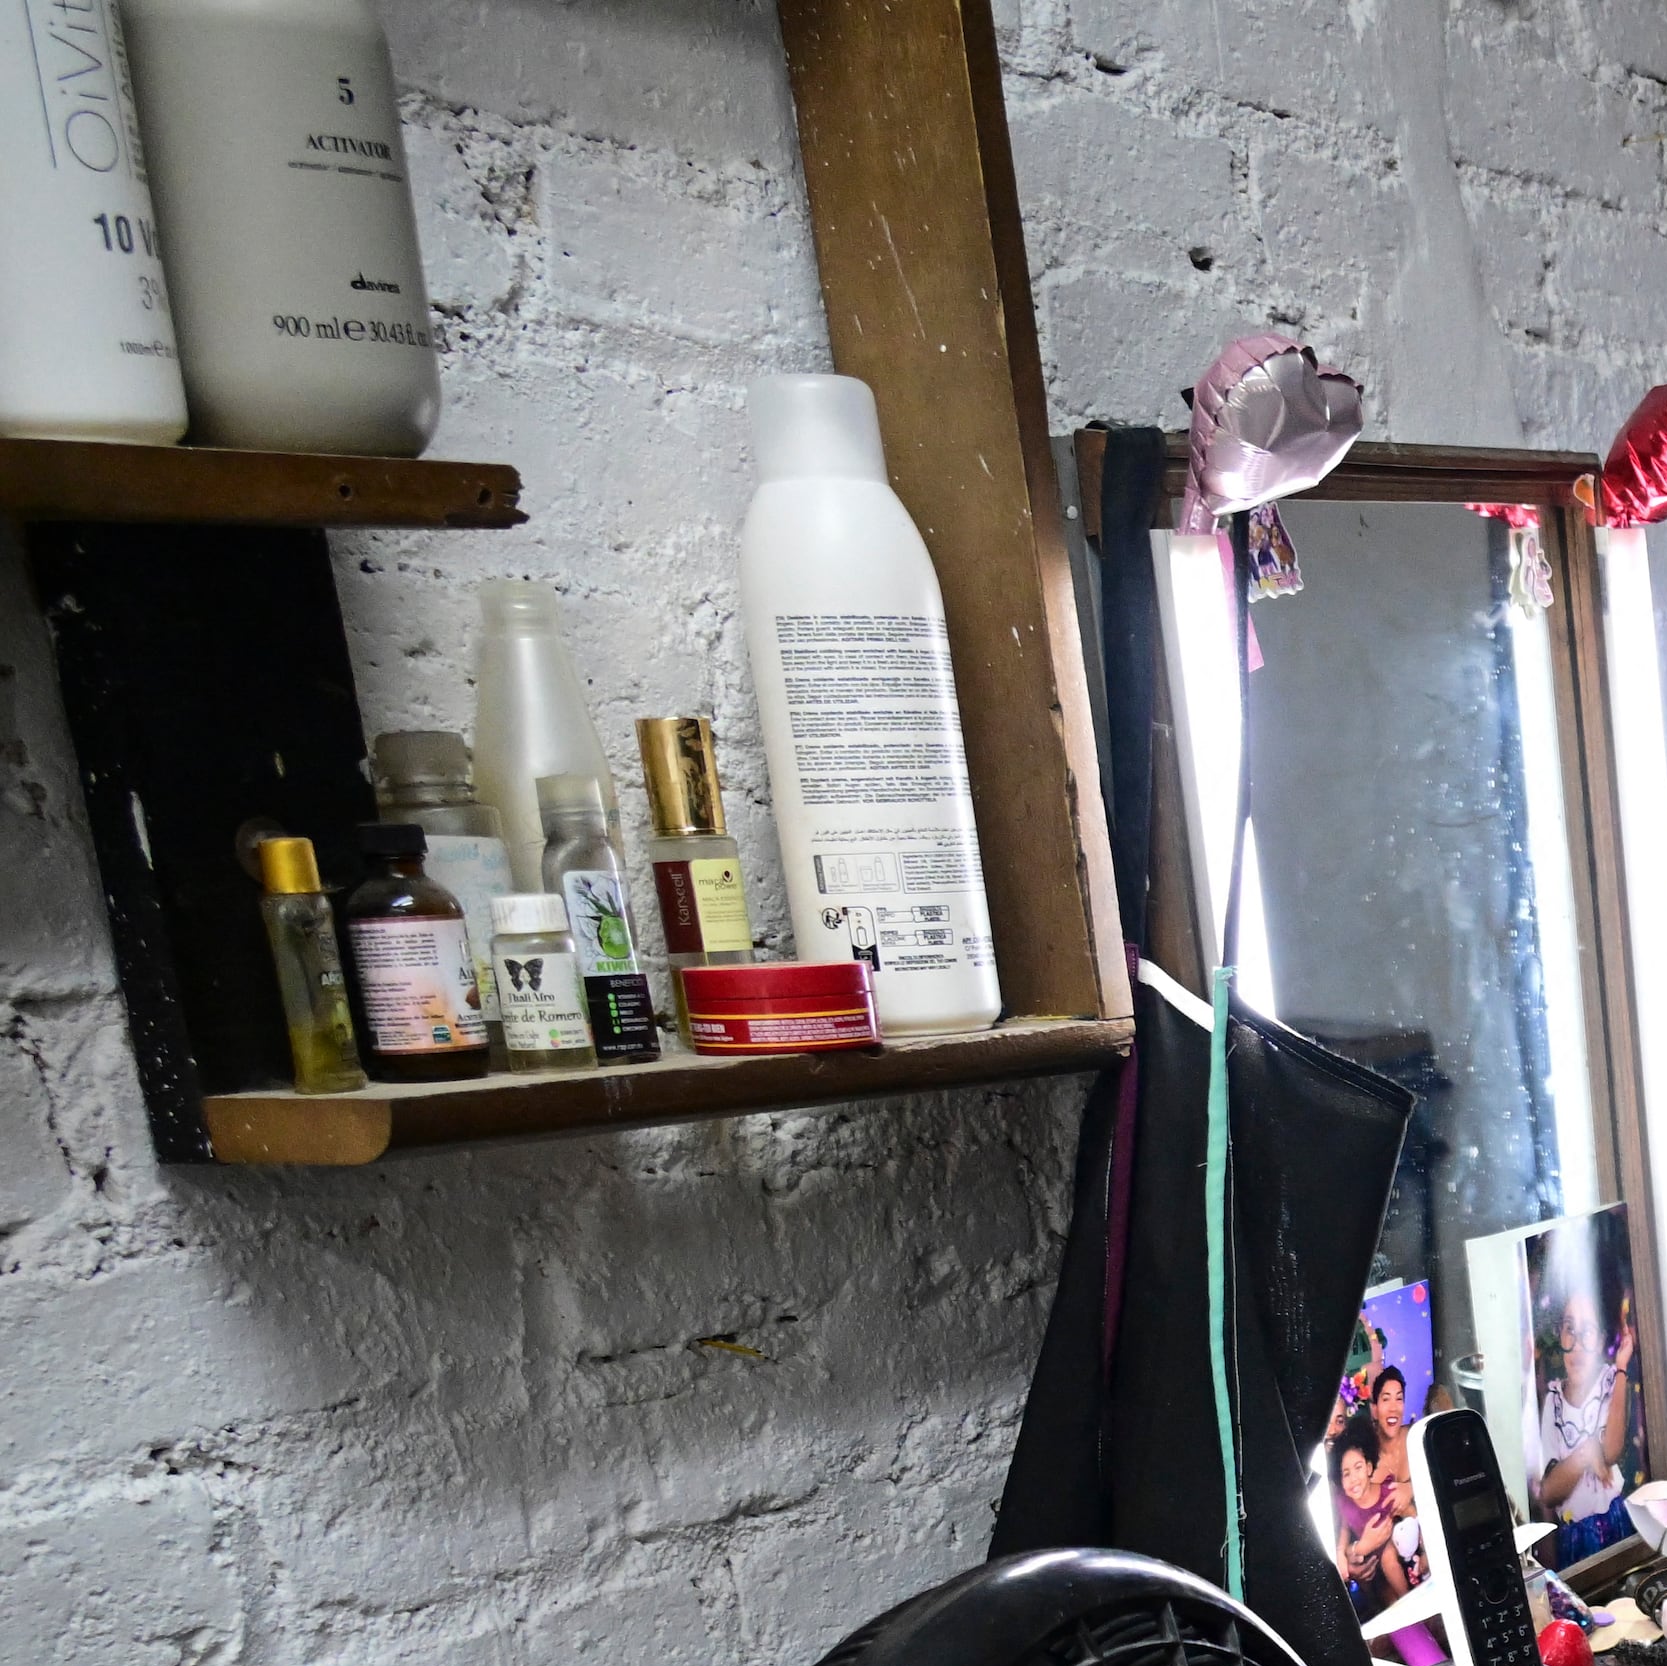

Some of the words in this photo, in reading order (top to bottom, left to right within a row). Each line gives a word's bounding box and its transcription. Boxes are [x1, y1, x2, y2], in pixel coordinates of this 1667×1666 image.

[337, 78, 355, 105] 5
[306, 133, 393, 161] ACTIVATOR
[93, 213, 135, 254] 10
[272, 314, 310, 338] 900
[315, 316, 342, 339] ml
[520, 1009, 536, 1023] de
[537, 1009, 583, 1022] Romero
